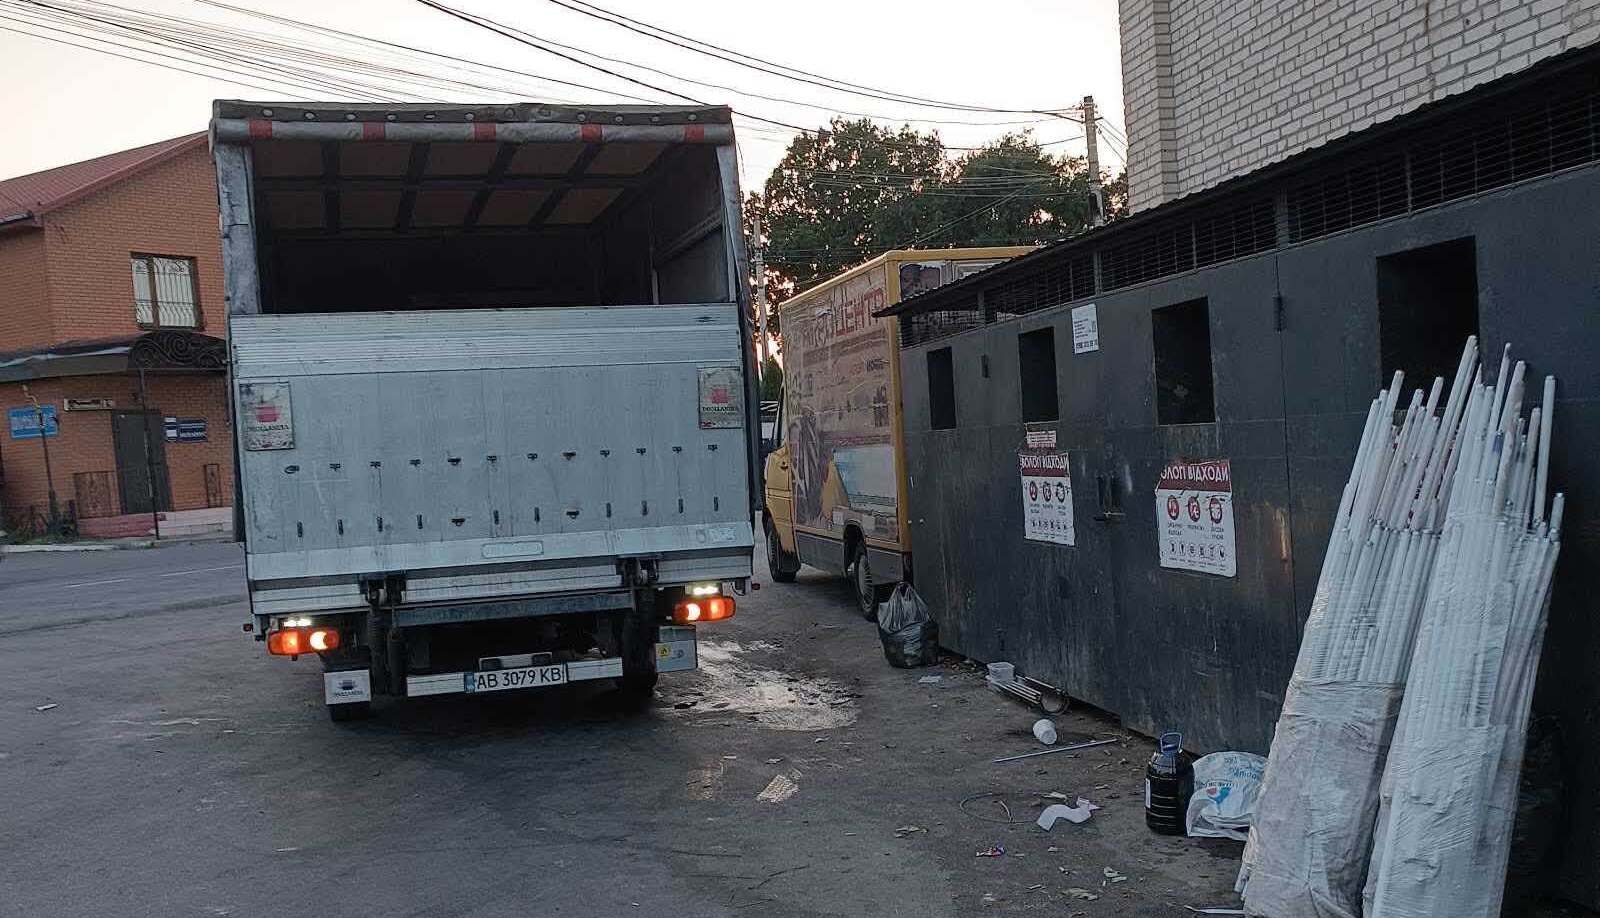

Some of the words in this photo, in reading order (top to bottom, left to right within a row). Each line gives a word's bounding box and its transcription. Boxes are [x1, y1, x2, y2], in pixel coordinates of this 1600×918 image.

[1187, 465, 1229, 482] ВІДХОДИ
[477, 673, 498, 689] AB
[502, 669, 536, 686] 3079
[540, 667, 561, 683] KB
